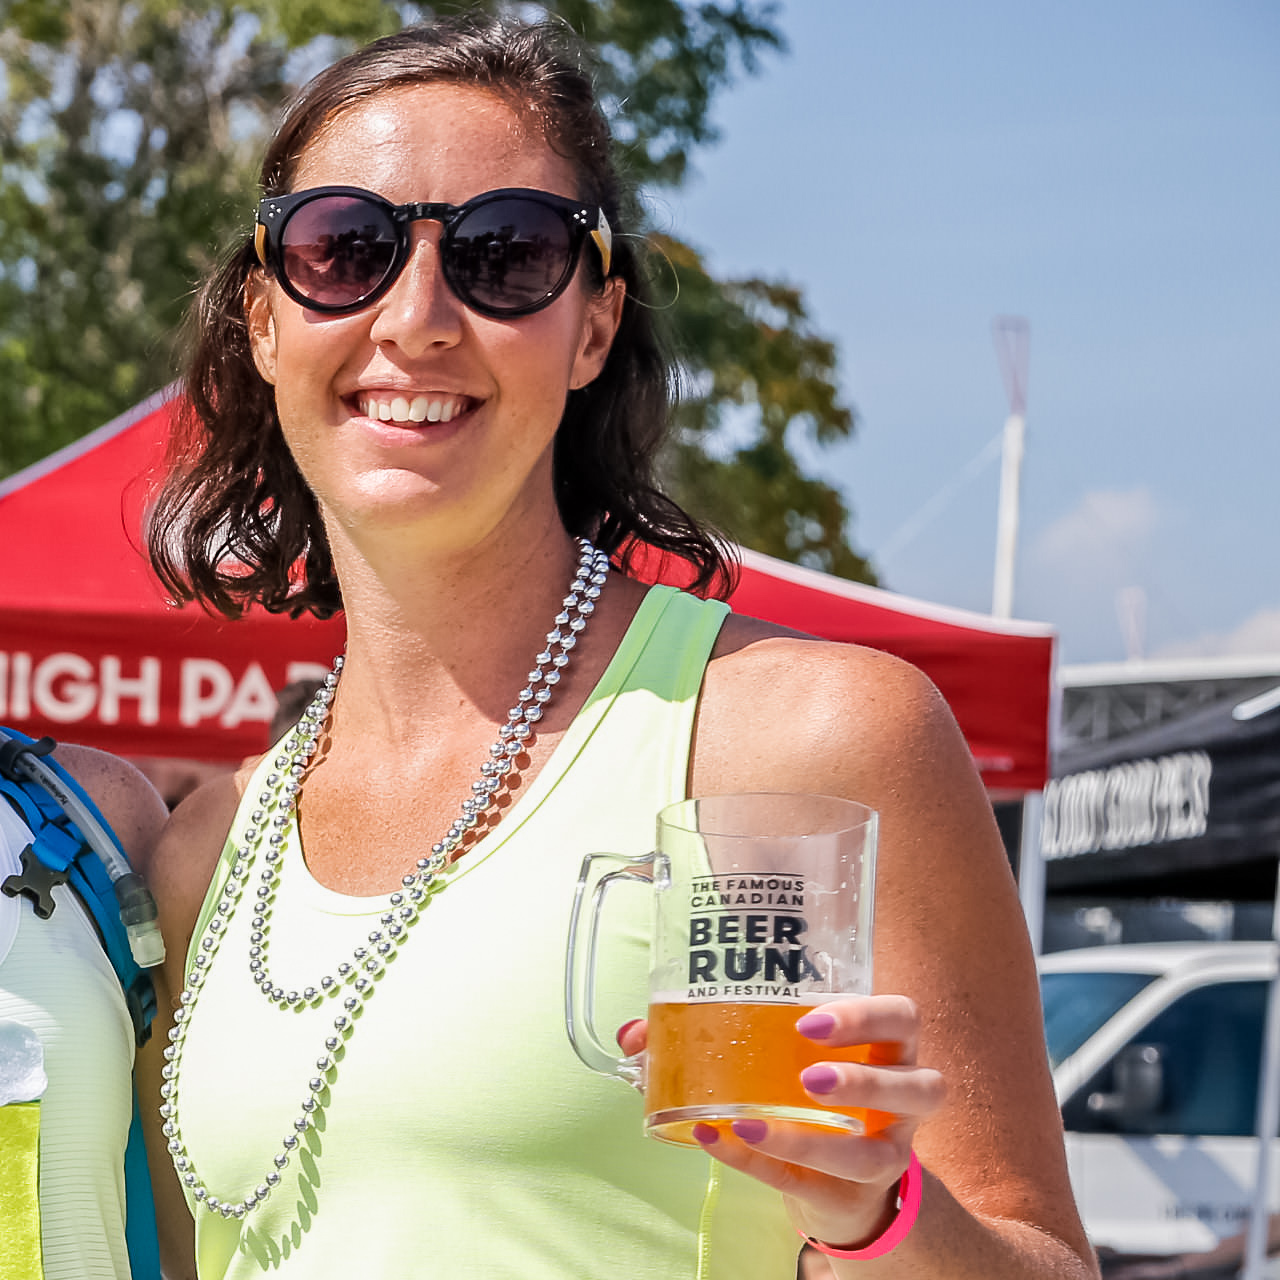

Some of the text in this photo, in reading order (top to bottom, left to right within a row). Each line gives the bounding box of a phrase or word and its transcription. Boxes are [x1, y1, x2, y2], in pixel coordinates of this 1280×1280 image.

[180, 658, 332, 729] PA
[691, 878, 805, 893] THE FAMOUS
[691, 893, 804, 908] CANADIAN
[690, 914, 804, 946] BEER
[688, 947, 802, 984] RUN
[687, 984, 801, 998] AND FESTIVAL
